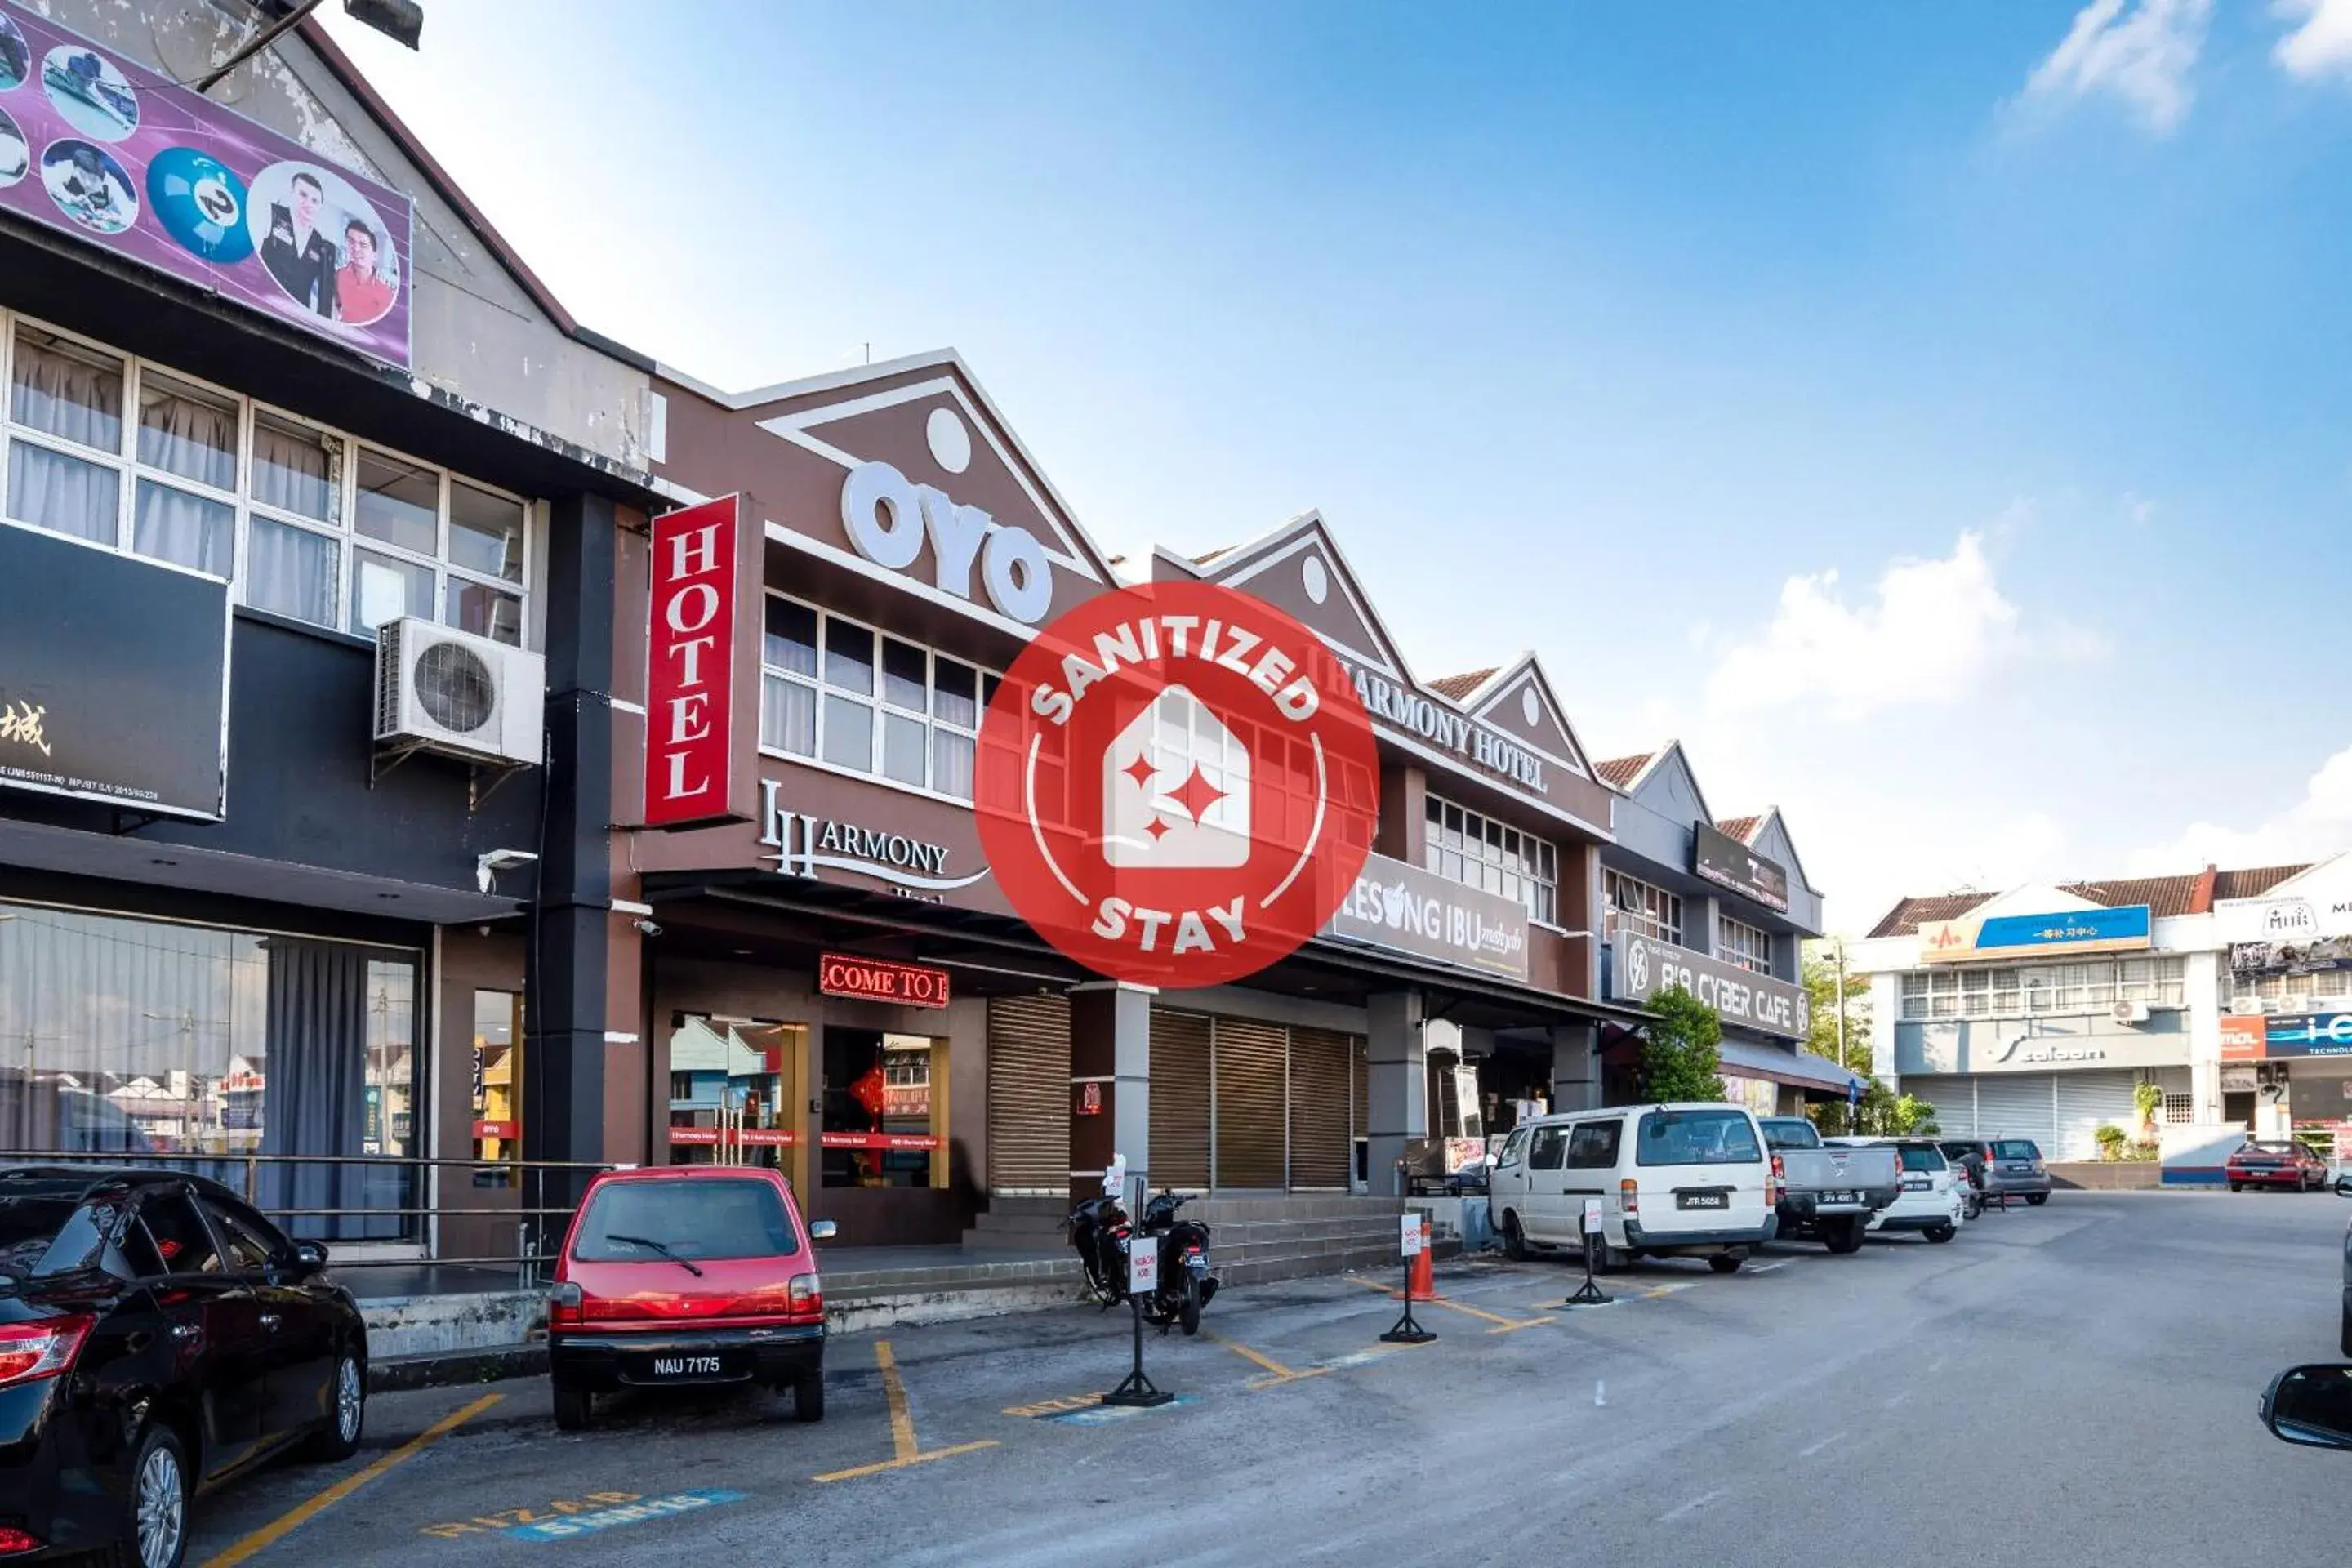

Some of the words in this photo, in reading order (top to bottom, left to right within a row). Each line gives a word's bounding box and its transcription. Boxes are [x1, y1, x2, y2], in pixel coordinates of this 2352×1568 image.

[841, 461, 1053, 623] OYO
[662, 523, 723, 800] HOTEL
[1474, 728, 1548, 794] HOTEL
[777, 809, 950, 880] HARMONY
[1446, 904, 1481, 951] IBU
[822, 964, 896, 994] COME
[899, 971, 932, 998] TO
[1698, 973, 1752, 1018] CYBER
[1756, 990, 1792, 1028] CAFE
[654, 1358, 683, 1374] NAU
[686, 1357, 720, 1373] 7175
